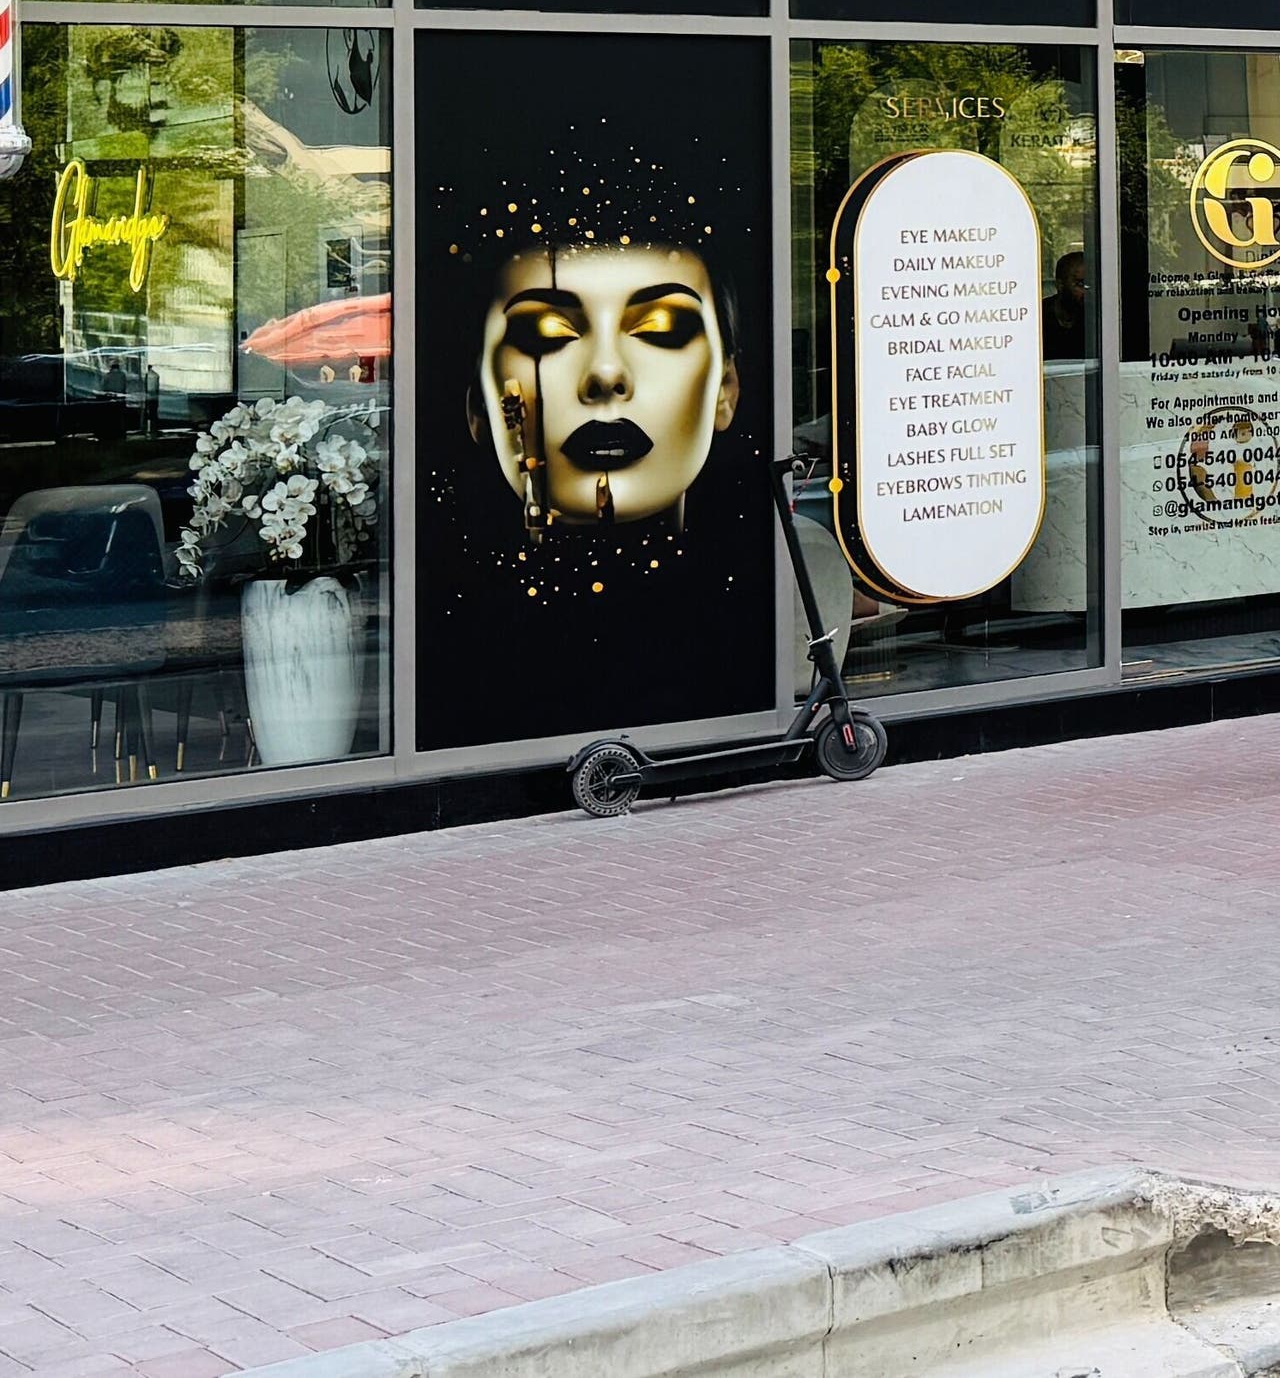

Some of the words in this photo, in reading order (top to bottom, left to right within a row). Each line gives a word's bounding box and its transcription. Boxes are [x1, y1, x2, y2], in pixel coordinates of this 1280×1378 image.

[900, 228, 929, 245] EYE
[933, 226, 997, 243] MAKEUP
[893, 255, 937, 273] DAILY
[941, 253, 1005, 270] MAKEUP
[1148, 272, 1190, 283] elcome
[881, 282, 949, 300] EVENING
[954, 280, 1017, 297] MAKEUP
[870, 312, 916, 329] CALM
[919, 310, 933, 326] &
[936, 309, 961, 326] GO
[965, 307, 1028, 324] MAKEUP
[1178, 305, 1249, 323] Opening
[888, 338, 945, 356] BRIDAL
[949, 335, 1013, 352] MAKEUP
[1188, 331, 1238, 344] Monday
[1151, 351, 1198, 368] 10:00
[1205, 350, 1233, 366] AM
[906, 365, 942, 382] FACE
[947, 363, 996, 380] FACIAL
[1151, 372, 1180, 383] Friday
[889, 395, 918, 411] EYE
[921, 389, 1014, 409] TREATMENT
[1151, 397, 1170, 410] For
[1174, 393, 1254, 410] Appointments
[1258, 390, 1278, 404] and
[906, 421, 948, 438] BABY
[951, 418, 997, 434] GLOW
[1146, 416, 1165, 429] We
[1167, 414, 1191, 427] also
[887, 449, 946, 468] LASHES
[950, 446, 983, 463] FULL
[987, 443, 1016, 460] SET
[876, 477, 963, 497] EYEBROWS
[966, 470, 1026, 489] TINTING
[902, 500, 1003, 522] LAMENATION
